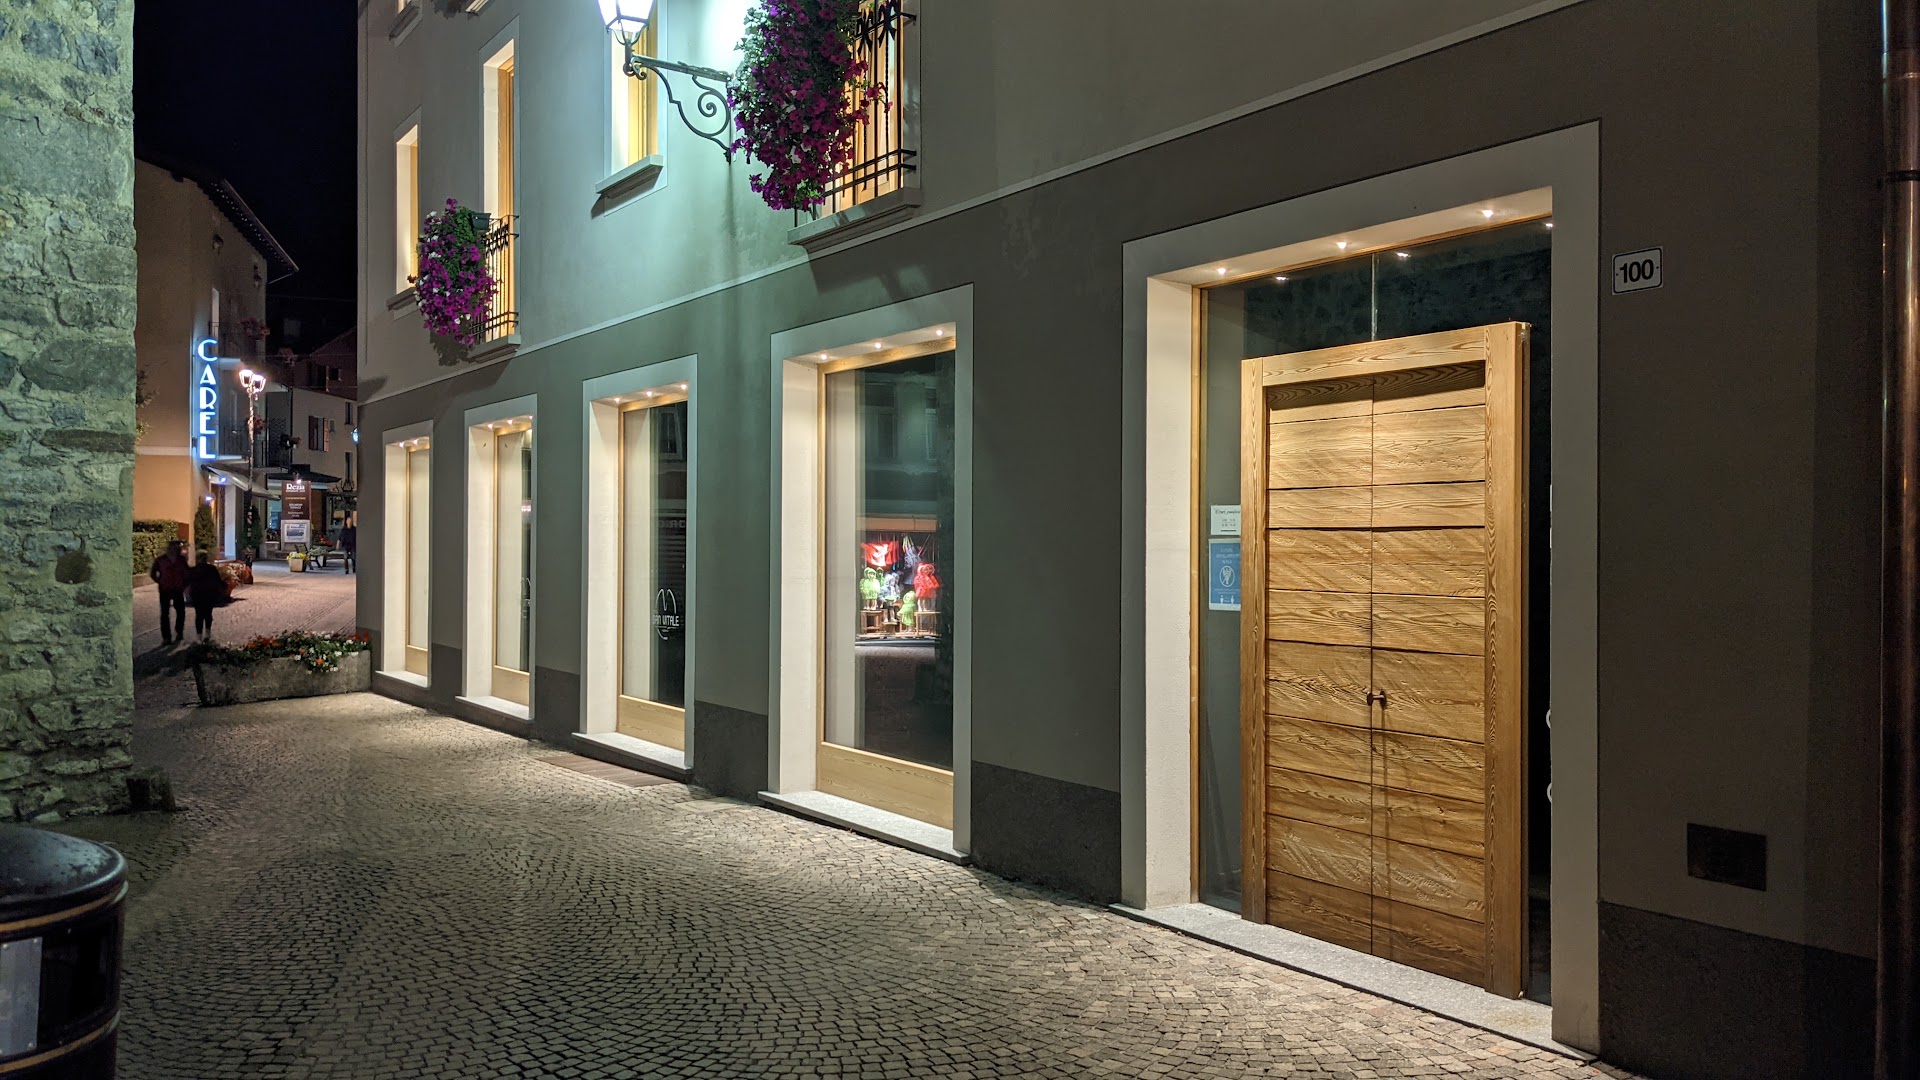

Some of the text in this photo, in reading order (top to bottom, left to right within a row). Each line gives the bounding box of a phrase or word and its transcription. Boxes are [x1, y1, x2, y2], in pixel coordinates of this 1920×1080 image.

[1620, 259, 1654, 283] 100
[198, 339, 218, 459] CAREL
[662, 615, 680, 627] VITALE
